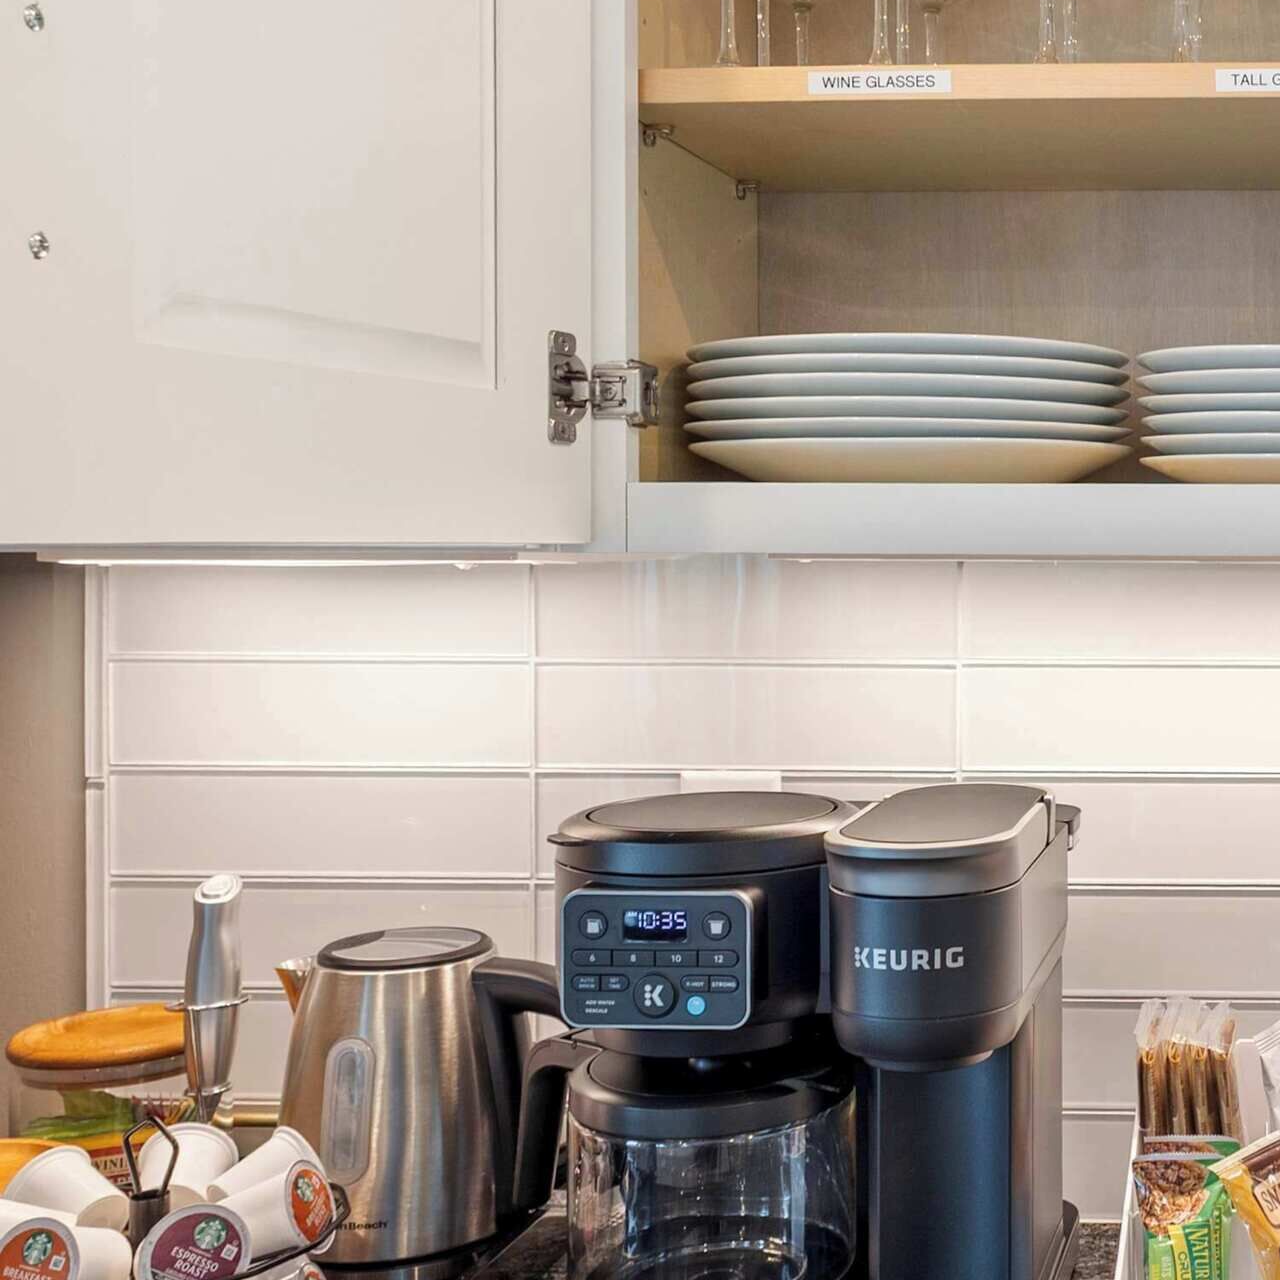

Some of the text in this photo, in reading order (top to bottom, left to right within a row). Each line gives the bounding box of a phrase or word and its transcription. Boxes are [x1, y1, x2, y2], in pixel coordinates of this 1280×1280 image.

[821, 74, 936, 89] WINE GLASSES
[1231, 73, 1268, 87] TALL
[637, 910, 688, 930] 10:35
[588, 954, 596, 963] 6
[670, 954, 682, 964] 10
[713, 954, 724, 964] 12
[853, 946, 965, 971] KEURIG
[170, 1246, 220, 1273] ESPRESSO
[174, 1259, 209, 1280] ROAST
